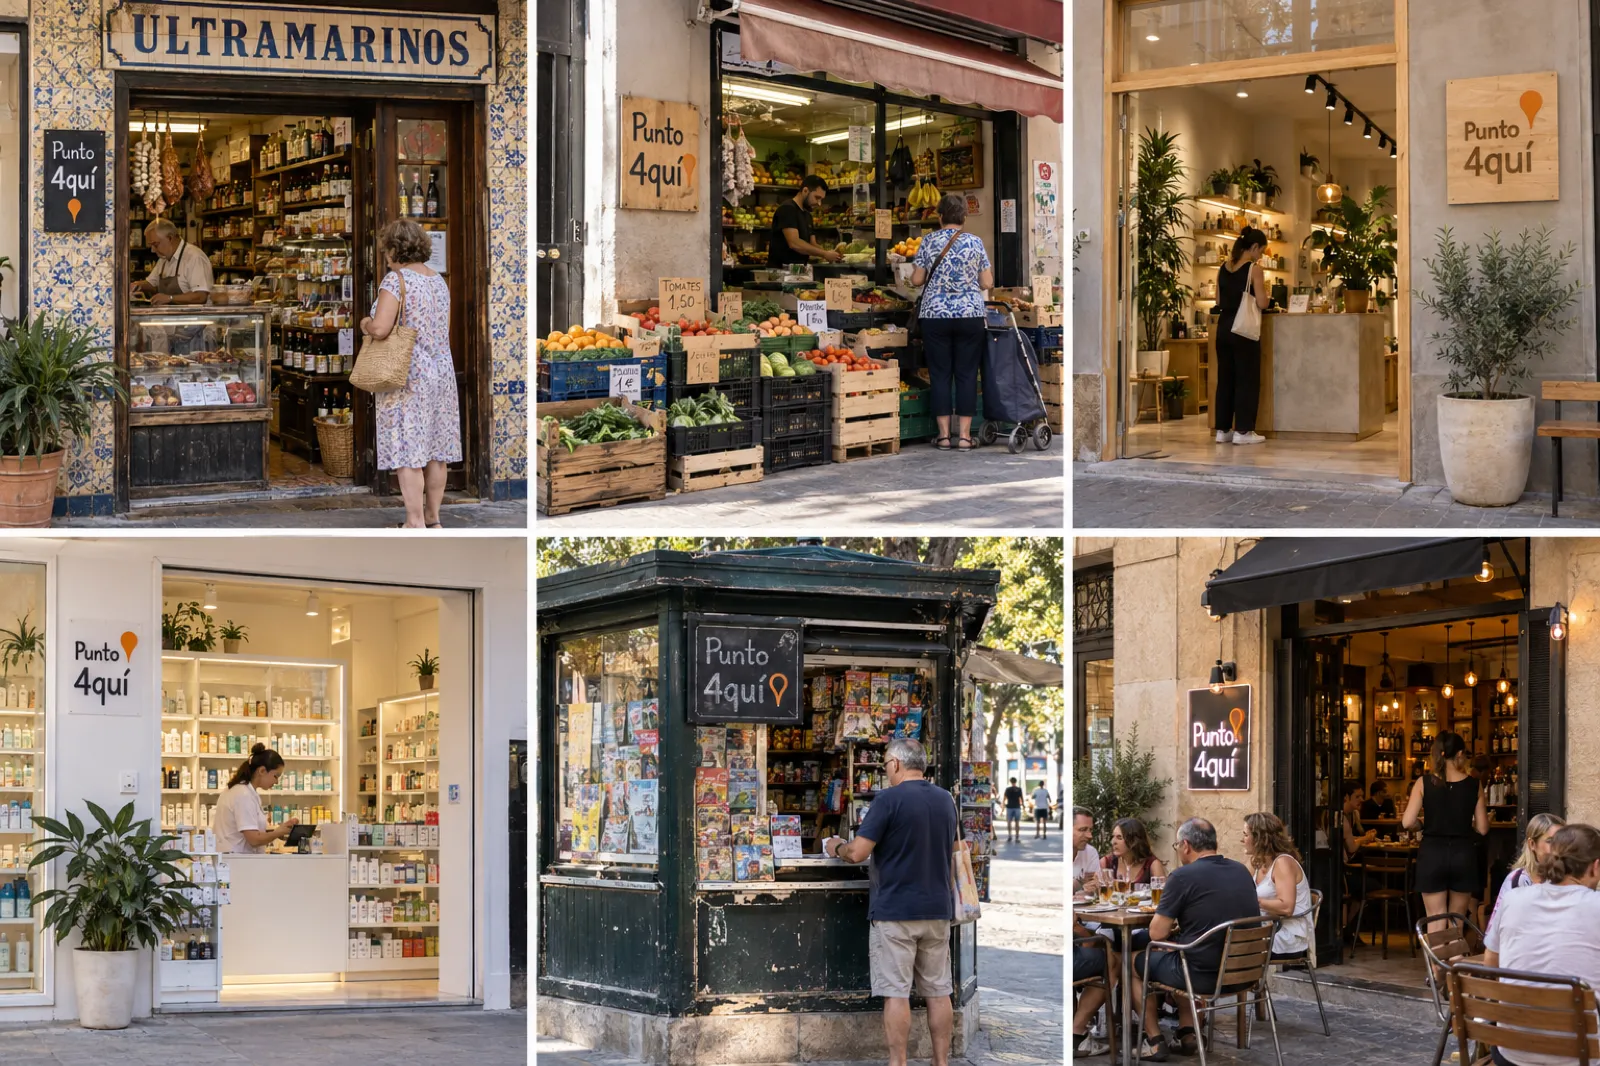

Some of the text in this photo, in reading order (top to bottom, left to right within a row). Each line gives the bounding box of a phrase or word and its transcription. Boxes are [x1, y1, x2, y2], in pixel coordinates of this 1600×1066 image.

[132, 13, 470, 67] ULTRAMARINOS
[632, 111, 684, 146] Punto
[1464, 119, 1520, 142] Punto
[52, 140, 95, 160] Punto
[1463, 140, 1535, 185] 4quí
[50, 165, 98, 197] 4quí
[629, 151, 684, 198] 4quí
[75, 640, 120, 662] Punto
[705, 636, 769, 666] Punto
[73, 666, 131, 706] 4quí
[703, 672, 767, 713] 4quí
[1193, 721, 1234, 748] Punto
[1193, 747, 1238, 787] 4quí
